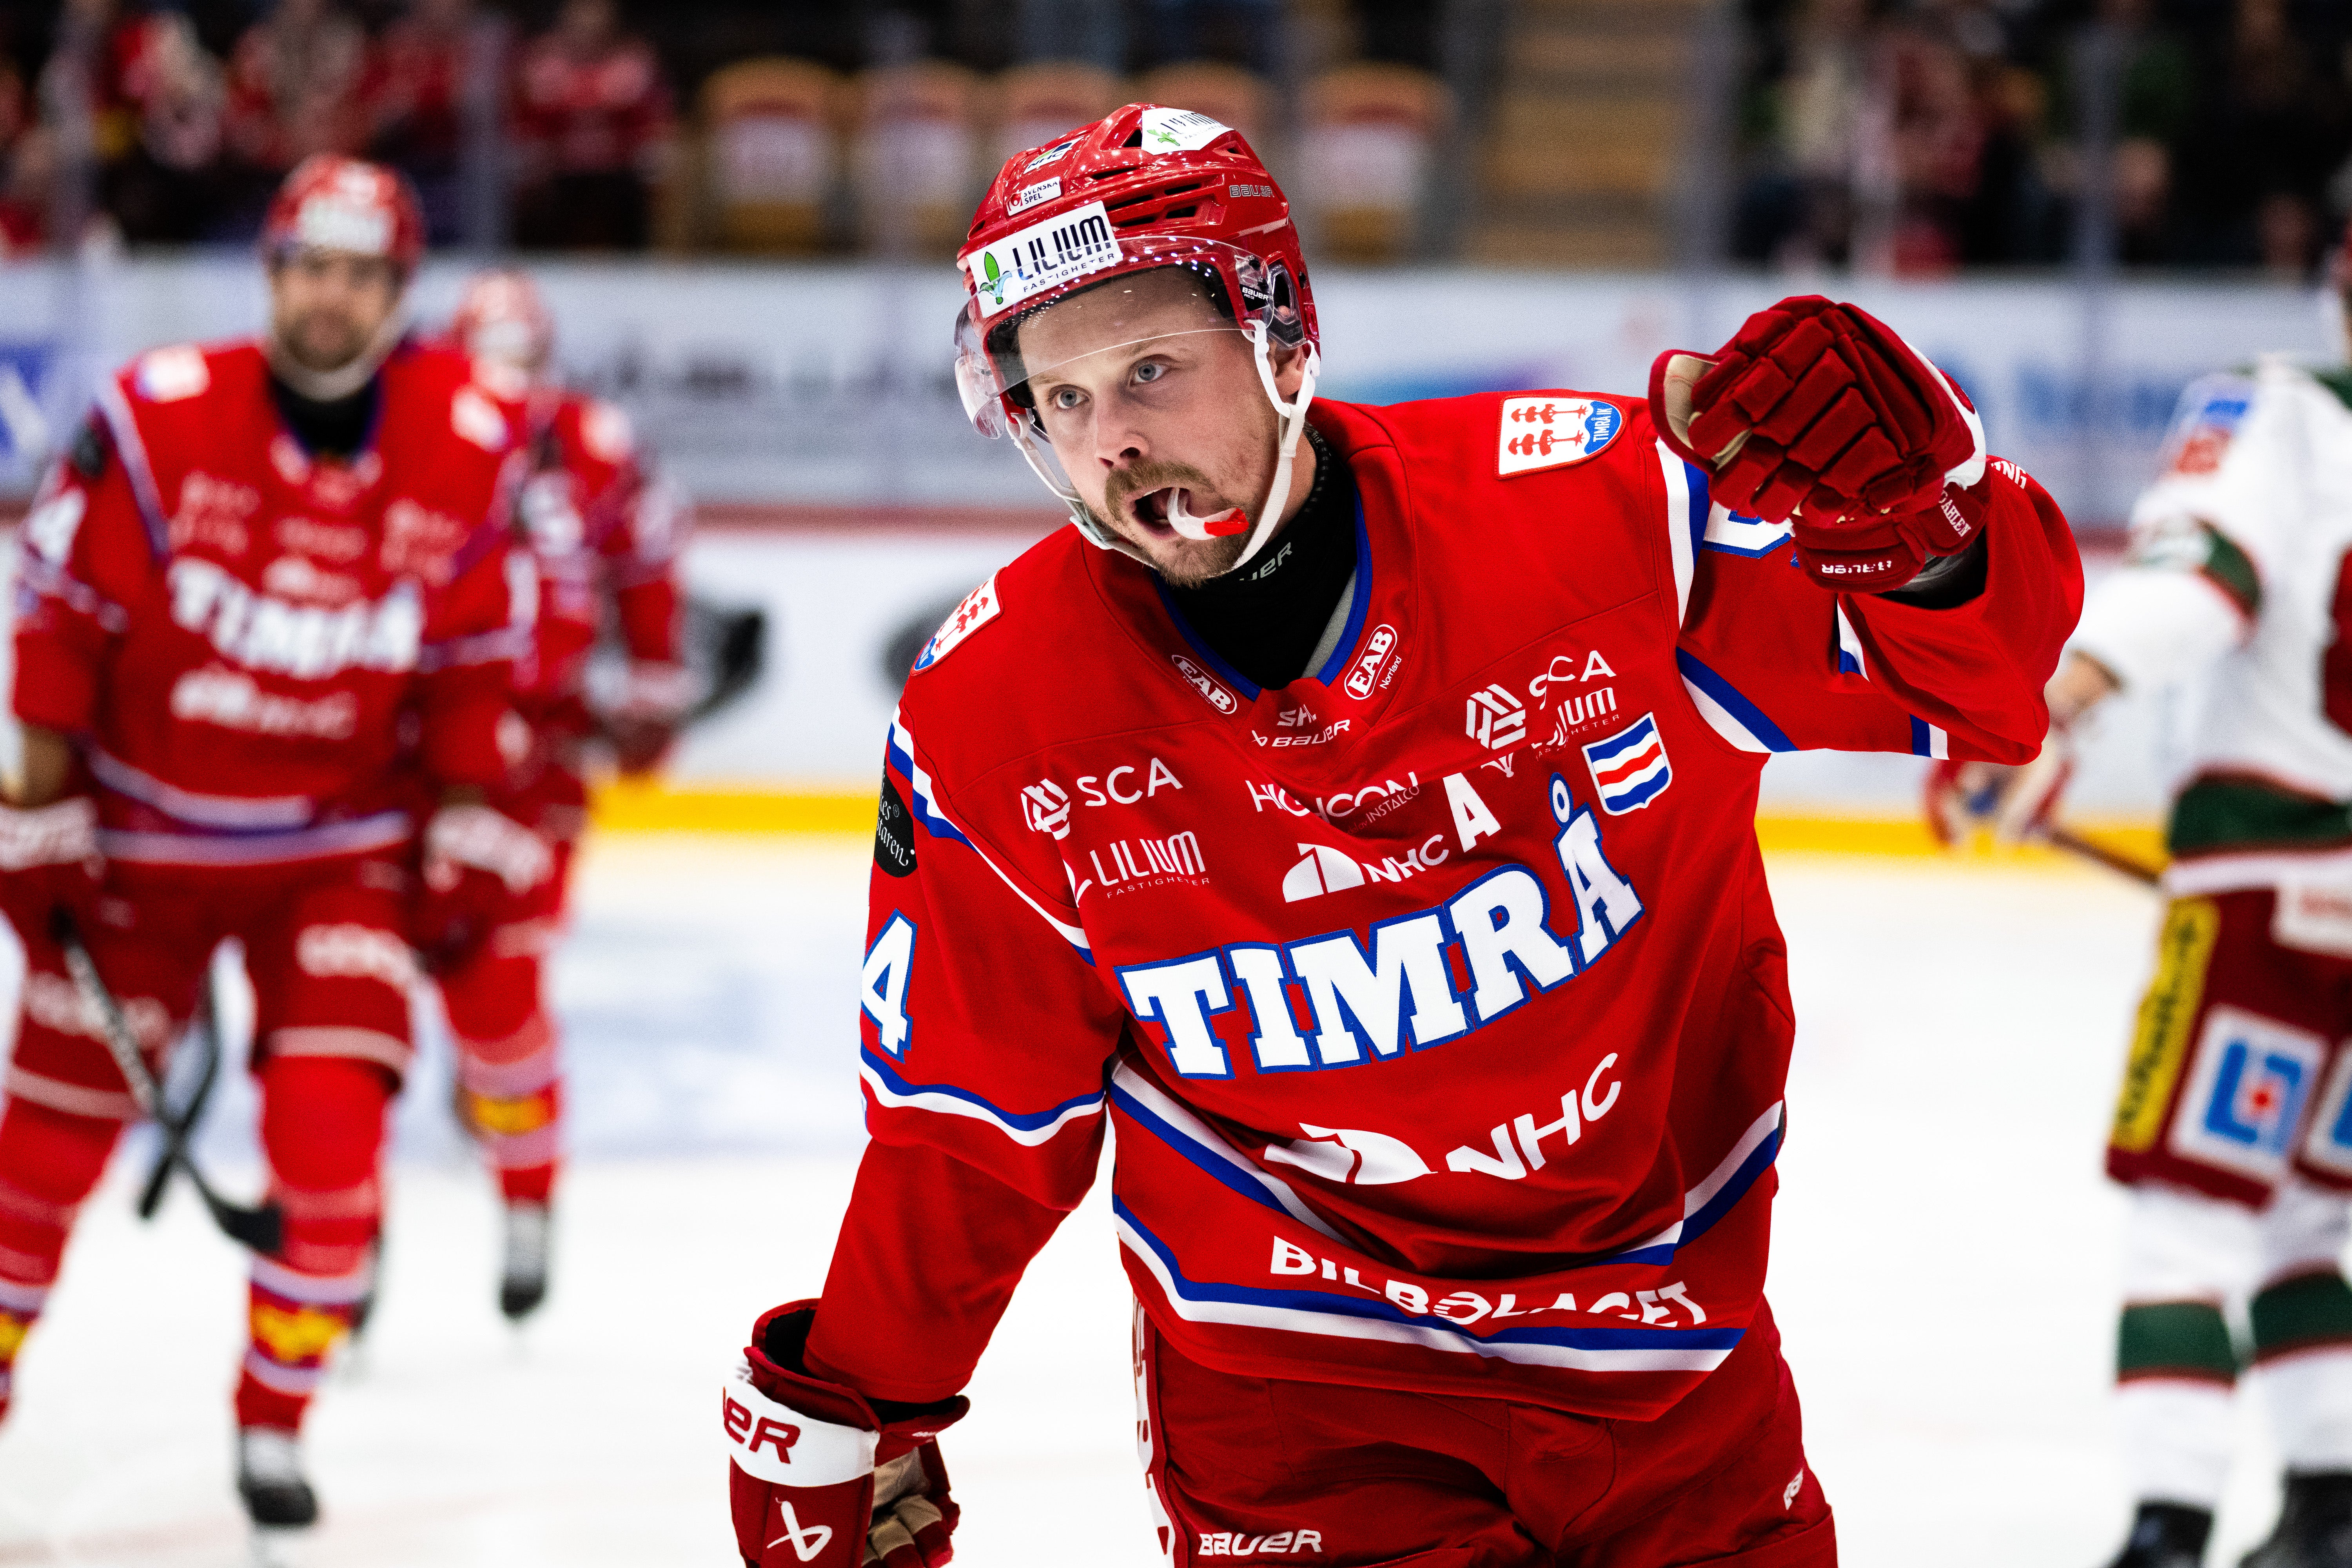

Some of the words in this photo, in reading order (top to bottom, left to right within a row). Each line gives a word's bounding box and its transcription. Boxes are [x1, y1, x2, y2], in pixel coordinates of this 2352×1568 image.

[1027, 151, 1063, 169] NHC
[1024, 181, 1058, 197] SVENSKA
[1025, 193, 1042, 204] SPEL
[1012, 215, 1111, 280] LILIUM
[1024, 253, 1114, 292] FASTIGHETER
[1591, 416, 1611, 442] TIMRÅ
[1176, 659, 1231, 710] EAB
[1347, 631, 1393, 695] EAB
[1379, 655, 1402, 689] Norrland
[1076, 757, 1183, 807] SCA
[1366, 786, 1419, 823] INSTALCO
[1443, 772, 1501, 852] A
[1089, 831, 1206, 887] LILIUM
[1361, 834, 1449, 883] NHC
[1107, 877, 1210, 899] FASTIGHETER
[1112, 772, 1646, 1080] TIMRÅ
[861, 907, 918, 1064] 4
[1445, 1052, 1621, 1180] NHC
[1270, 1235, 1707, 1328] BILBOLAGET
[723, 1386, 801, 1465] ER
